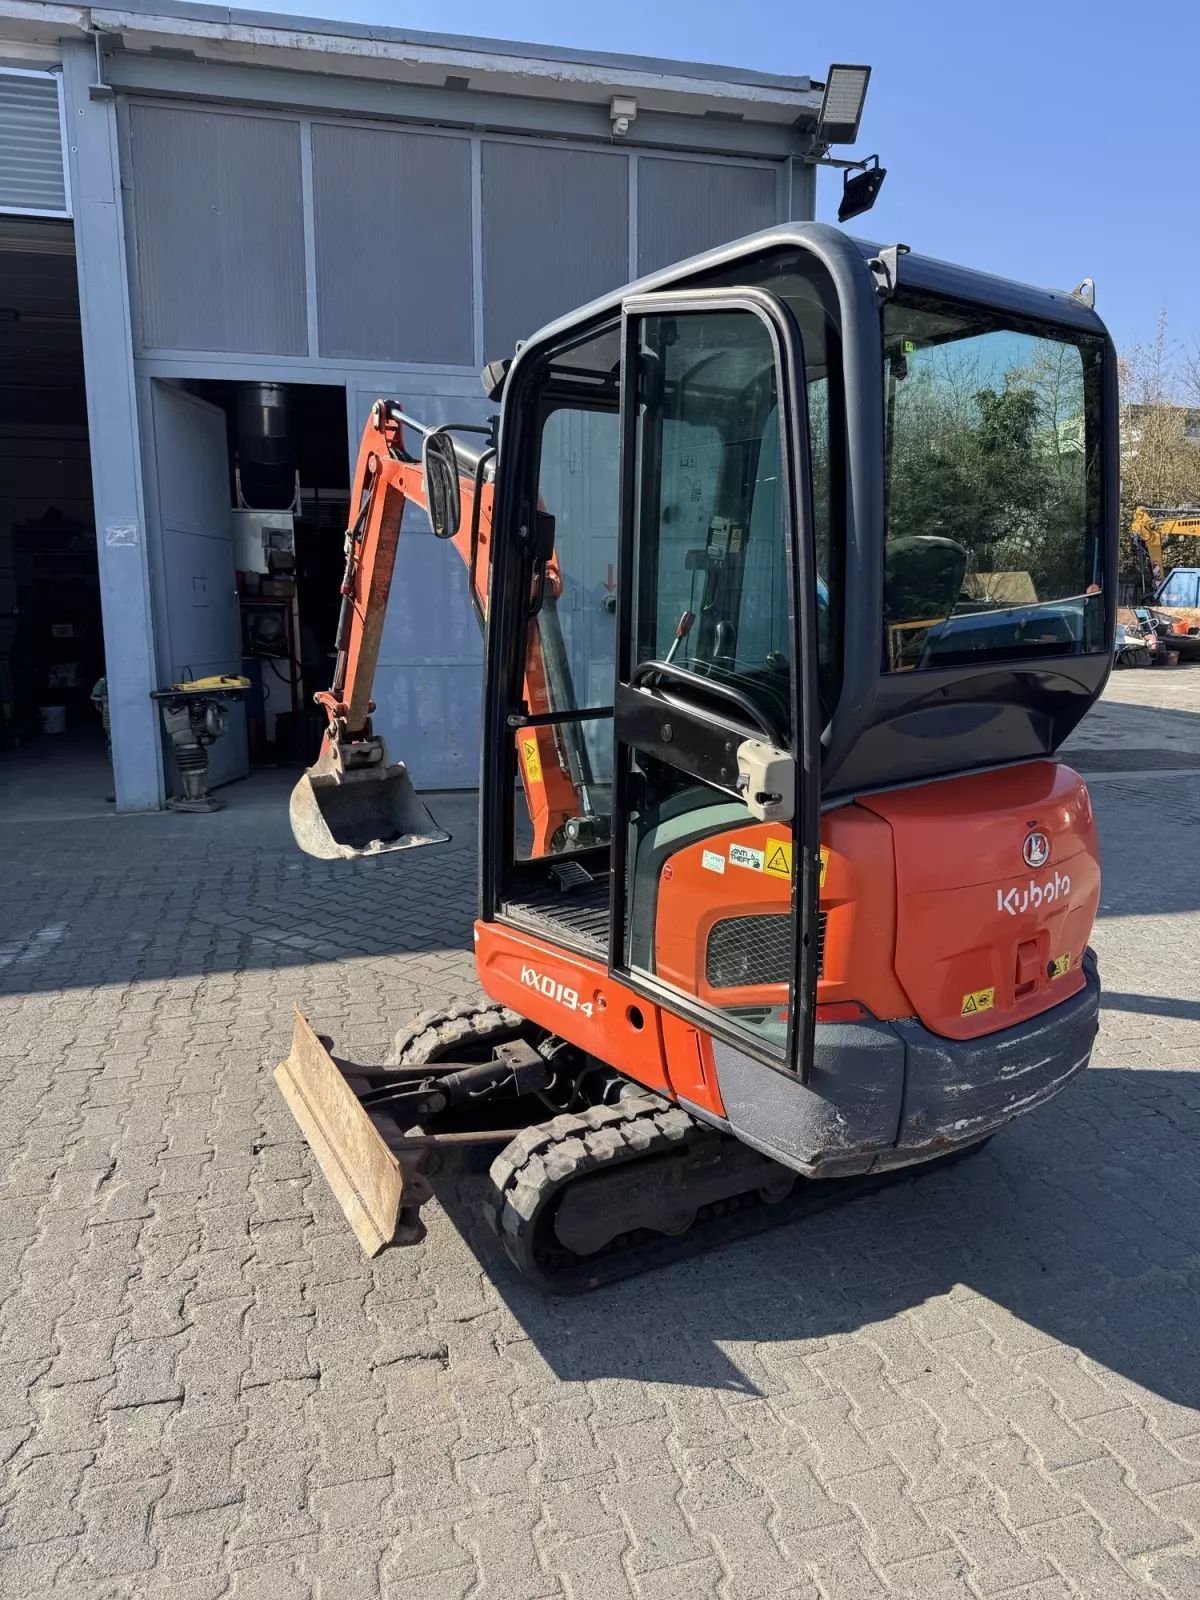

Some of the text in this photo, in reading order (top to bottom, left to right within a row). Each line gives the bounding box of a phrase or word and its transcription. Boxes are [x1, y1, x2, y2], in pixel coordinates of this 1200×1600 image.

[730, 854, 751, 864] THEFT
[731, 848, 748, 857] ANTI
[997, 872, 1070, 915] Kubota
[521, 964, 593, 1018] KX019-4
